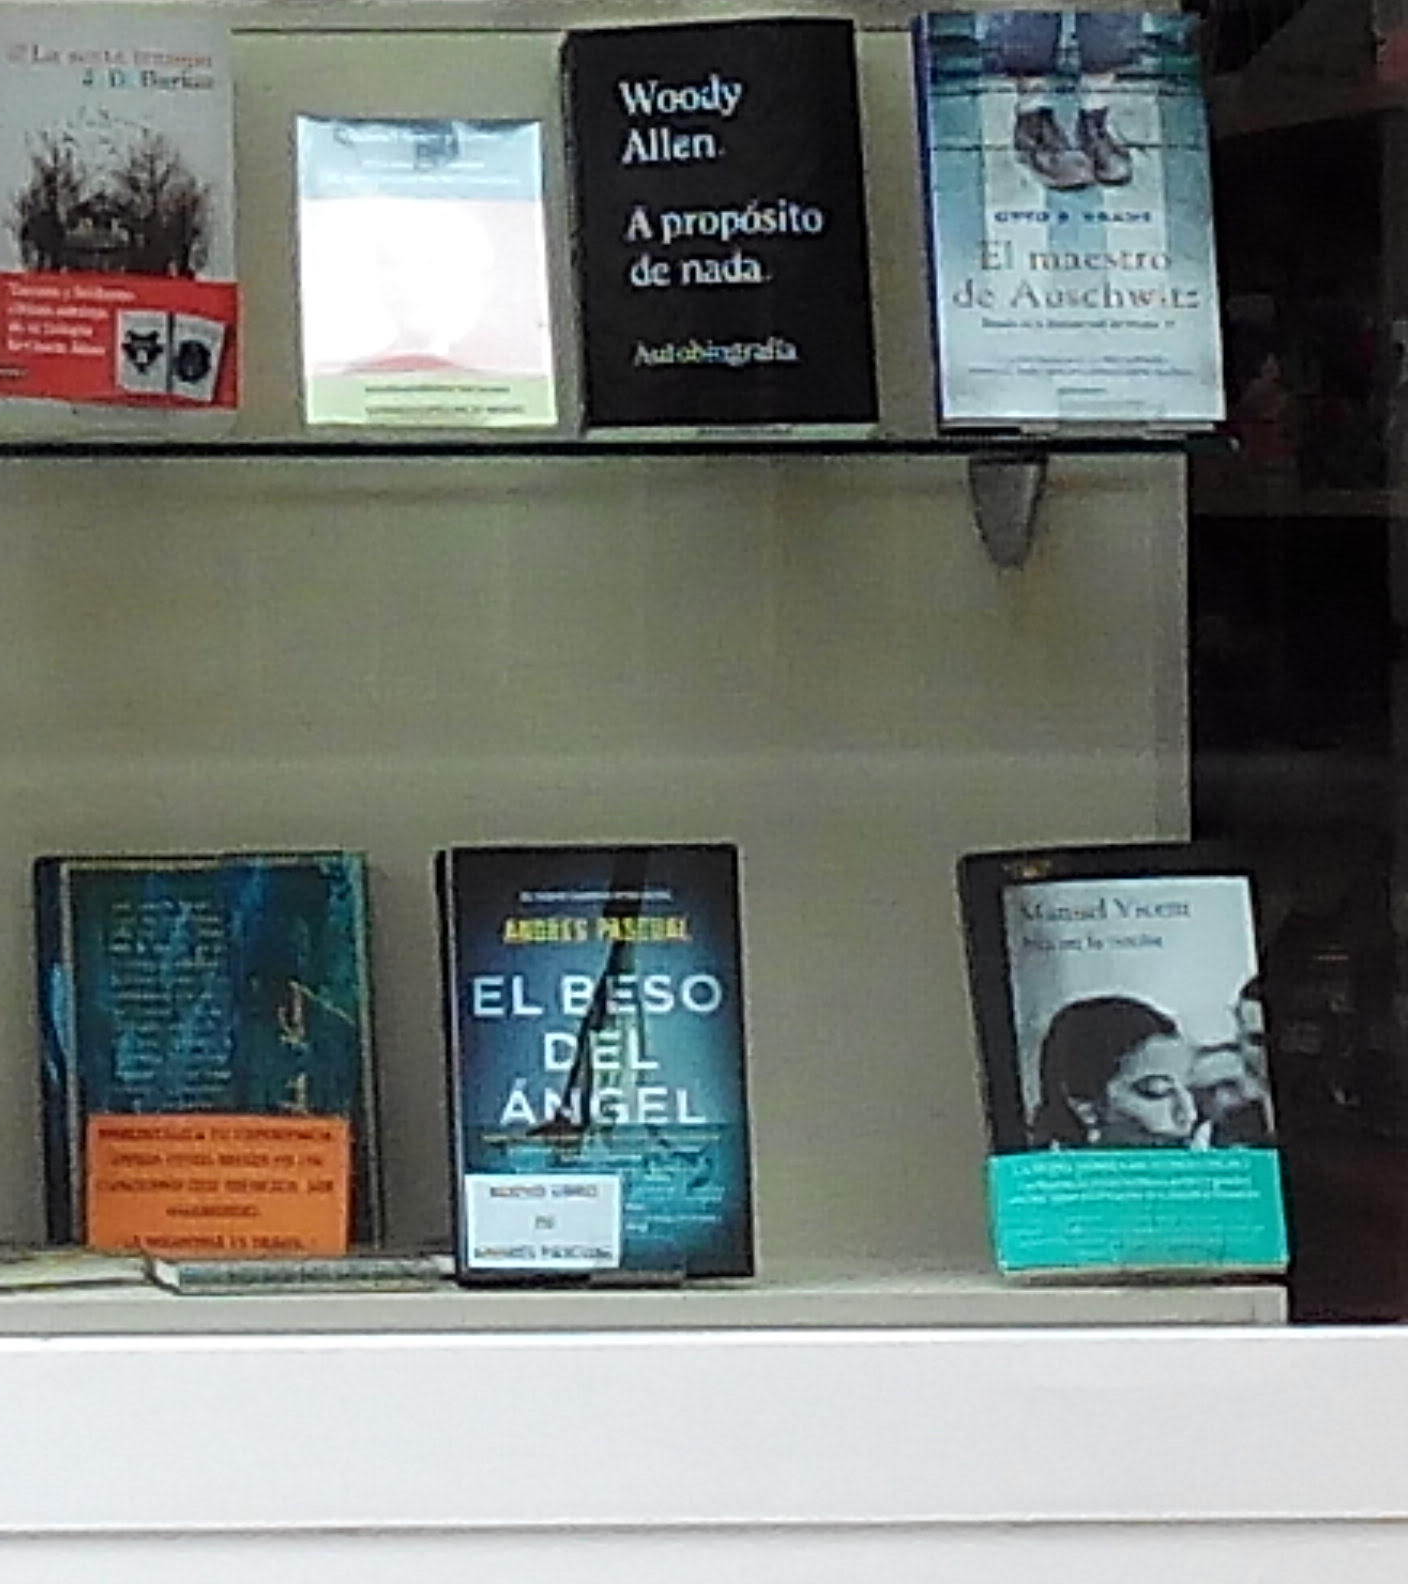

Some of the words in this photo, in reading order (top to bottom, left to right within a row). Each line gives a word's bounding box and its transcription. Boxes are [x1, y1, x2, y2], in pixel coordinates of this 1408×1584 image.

[618, 72, 743, 117] Woody
[623, 203, 655, 243] A
[659, 197, 826, 246] propósito
[629, 252, 672, 288] de
[980, 239, 1014, 272] El
[1029, 247, 1174, 272] maestro
[952, 278, 996, 310] de
[1009, 277, 1202, 311] Auschwitz
[471, 974, 544, 1018] EL
[561, 972, 724, 1017] BESO
[542, 1027, 661, 1073] DEL
[498, 1075, 707, 1128] ÁNGEL
